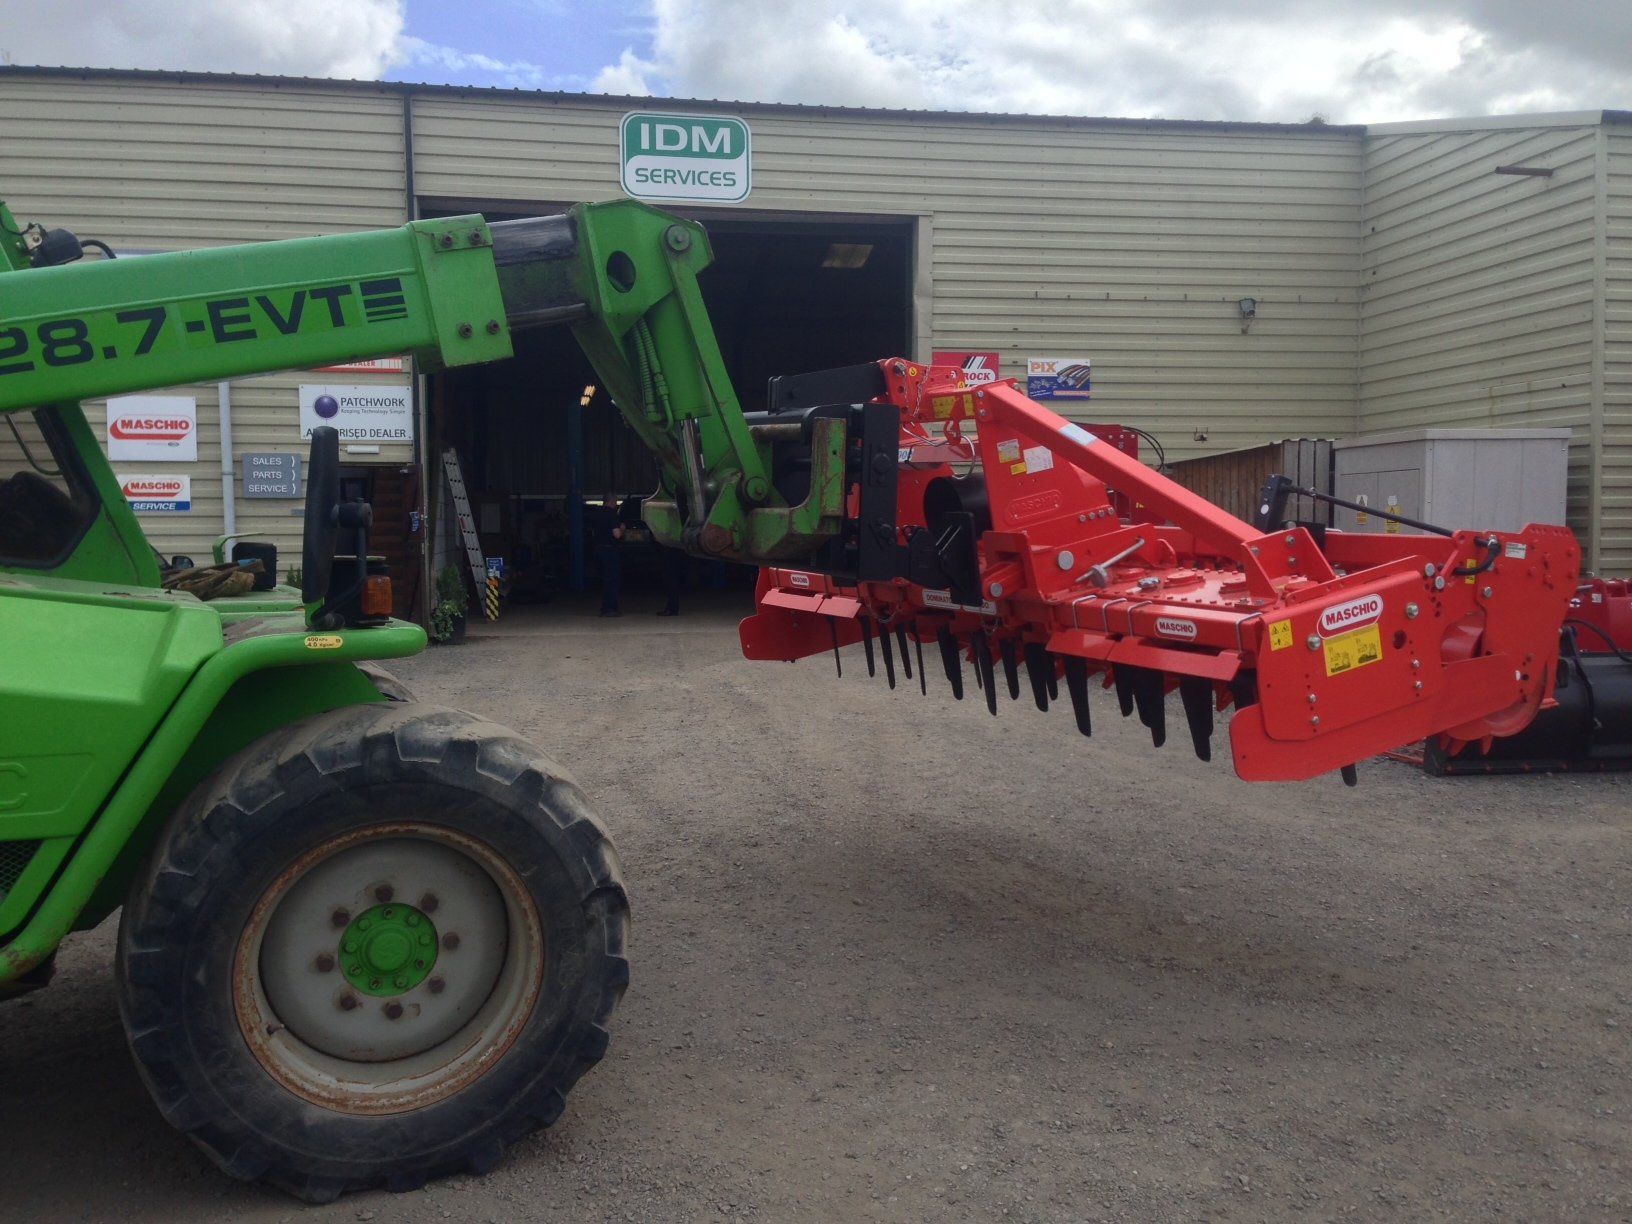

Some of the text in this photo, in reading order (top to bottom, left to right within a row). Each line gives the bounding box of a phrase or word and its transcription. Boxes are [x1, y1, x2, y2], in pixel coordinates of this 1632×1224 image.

[640, 123, 731, 154] IDM
[634, 167, 737, 187] SERVICES
[1030, 361, 1057, 373] PIX
[340, 397, 405, 407] PATCHWORK
[120, 419, 190, 430] MASCHIO
[306, 428, 406, 438] ARISED DEALER
[252, 457, 282, 466] SALES
[252, 471, 282, 479] PARTS
[130, 481, 181, 490] MASCHIO
[248, 484, 288, 493] SERVICE
[132, 502, 177, 510] SERVICE
[1325, 600, 1379, 626] MASCHIO
[1159, 620, 1194, 634] MASCHIO
